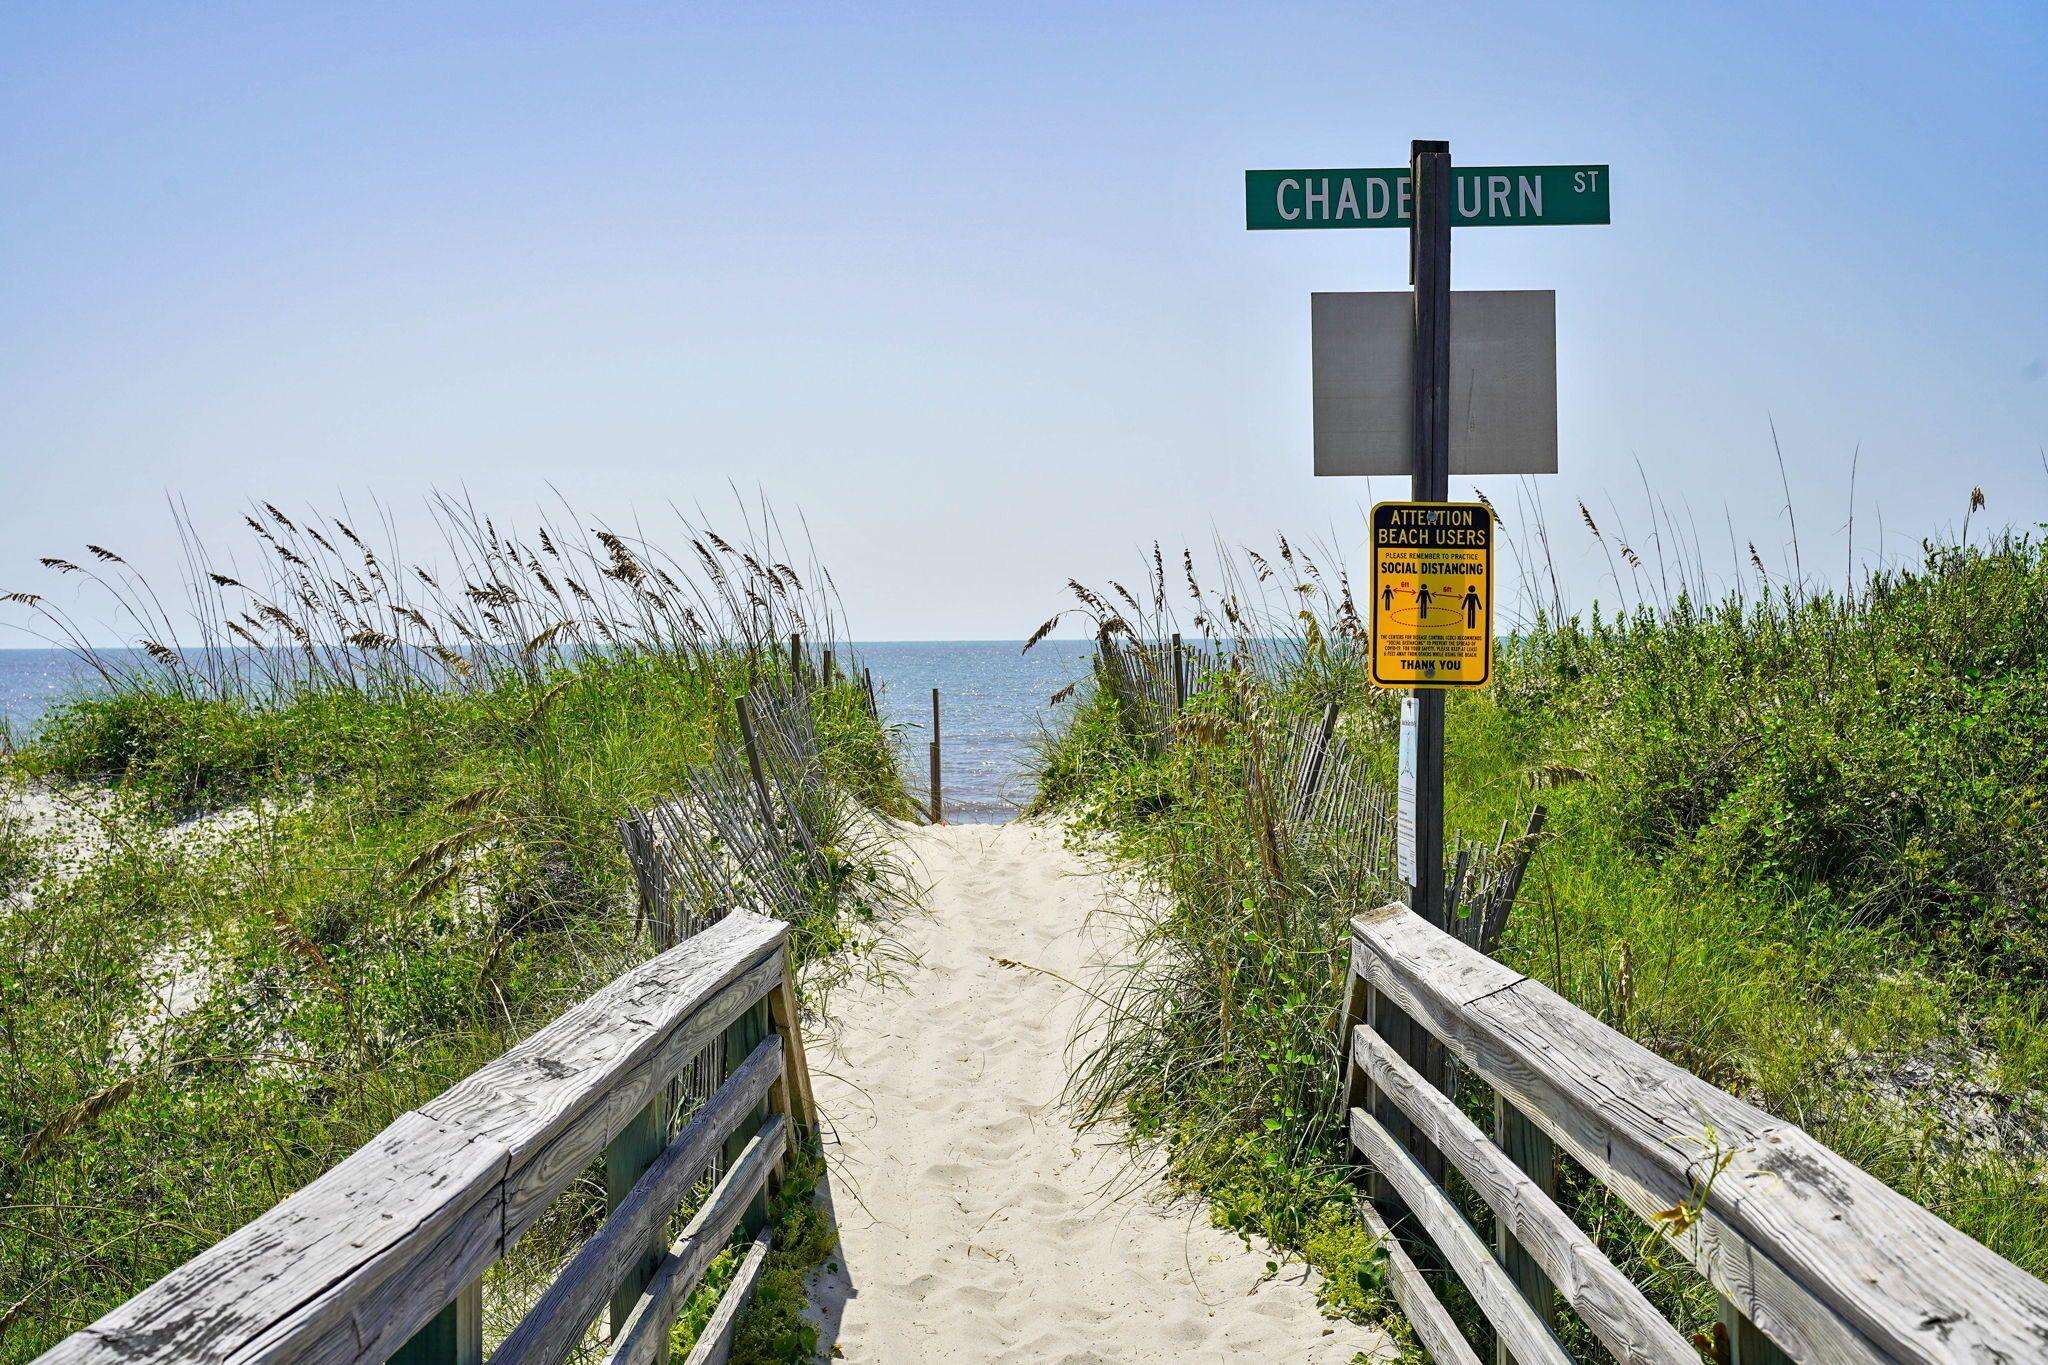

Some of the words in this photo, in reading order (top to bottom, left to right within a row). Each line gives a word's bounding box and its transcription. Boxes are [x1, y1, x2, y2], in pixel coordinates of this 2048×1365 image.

[1276, 175, 1542, 221] CHADURN
[1573, 170, 1599, 192] ST
[1378, 528, 1428, 544] BEACH
[1436, 529, 1485, 545] USERS
[1381, 562, 1418, 574] SOCIAL
[1421, 563, 1483, 574] DISTANCING
[1401, 660, 1435, 670] THANK
[1439, 661, 1460, 670] YOU
